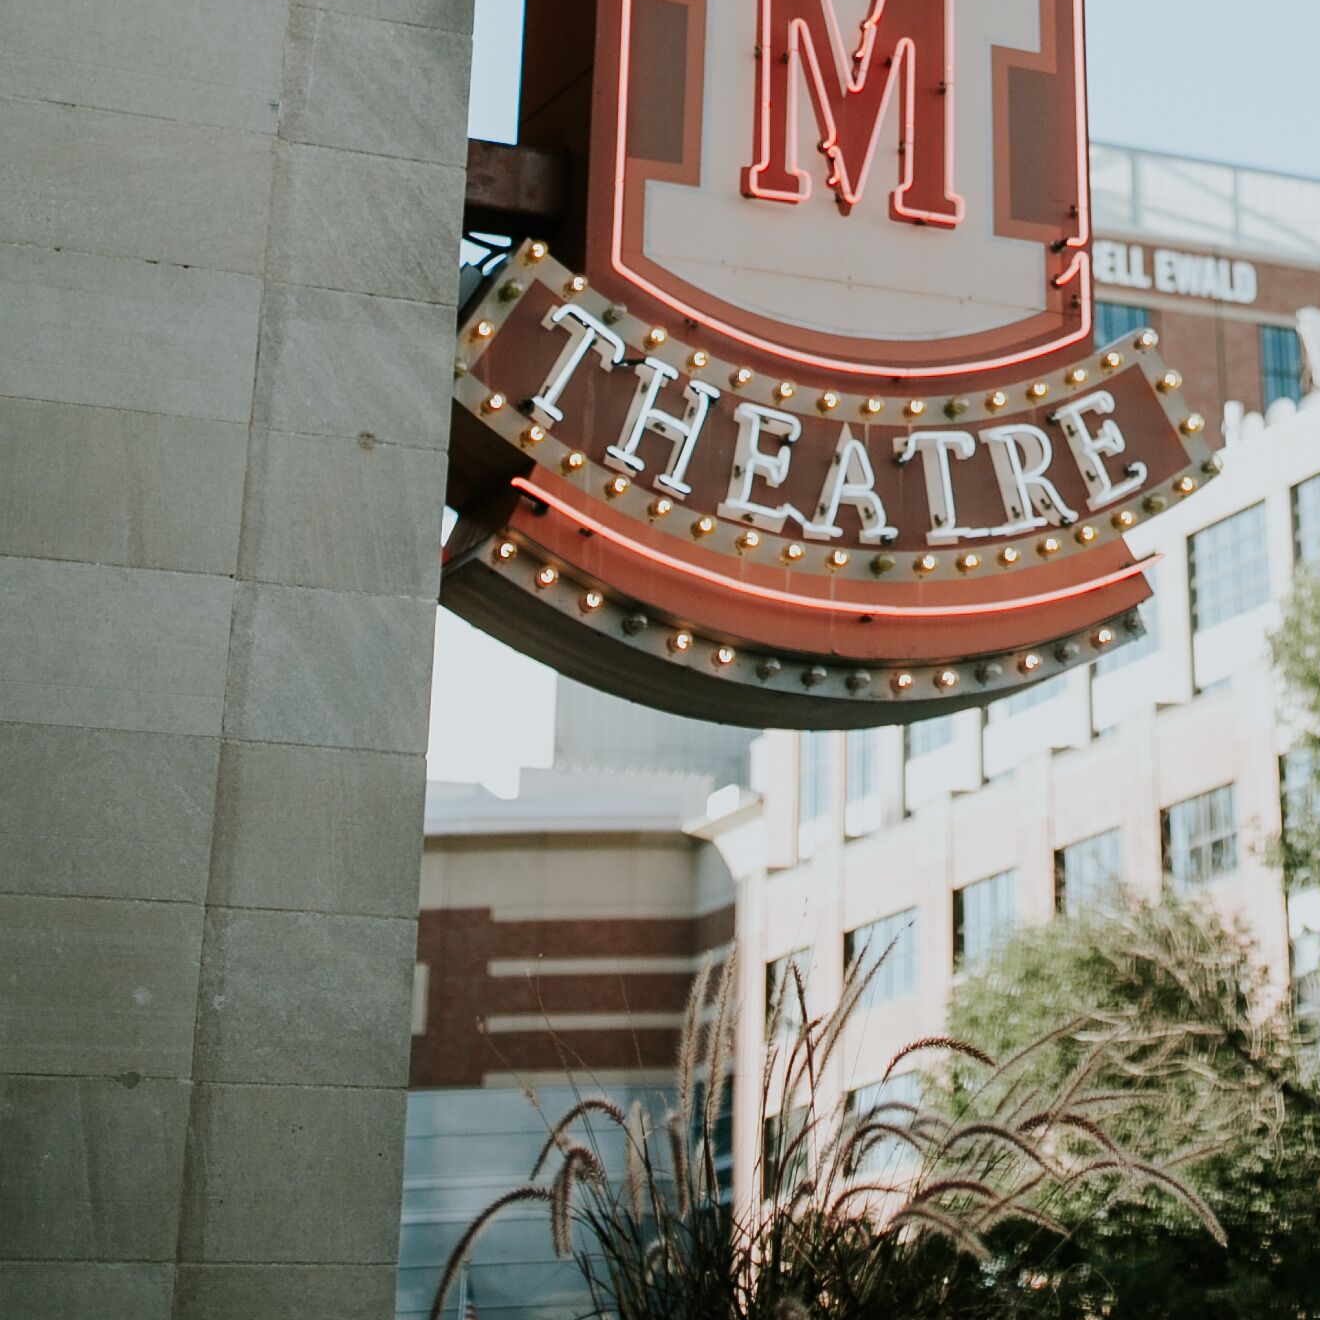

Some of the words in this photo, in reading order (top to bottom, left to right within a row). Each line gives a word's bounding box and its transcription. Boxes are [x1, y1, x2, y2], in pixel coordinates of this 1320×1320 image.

[1091, 239, 1153, 289] ELL
[1154, 248, 1258, 305] EWALD
[527, 302, 1148, 546] THEATRE
